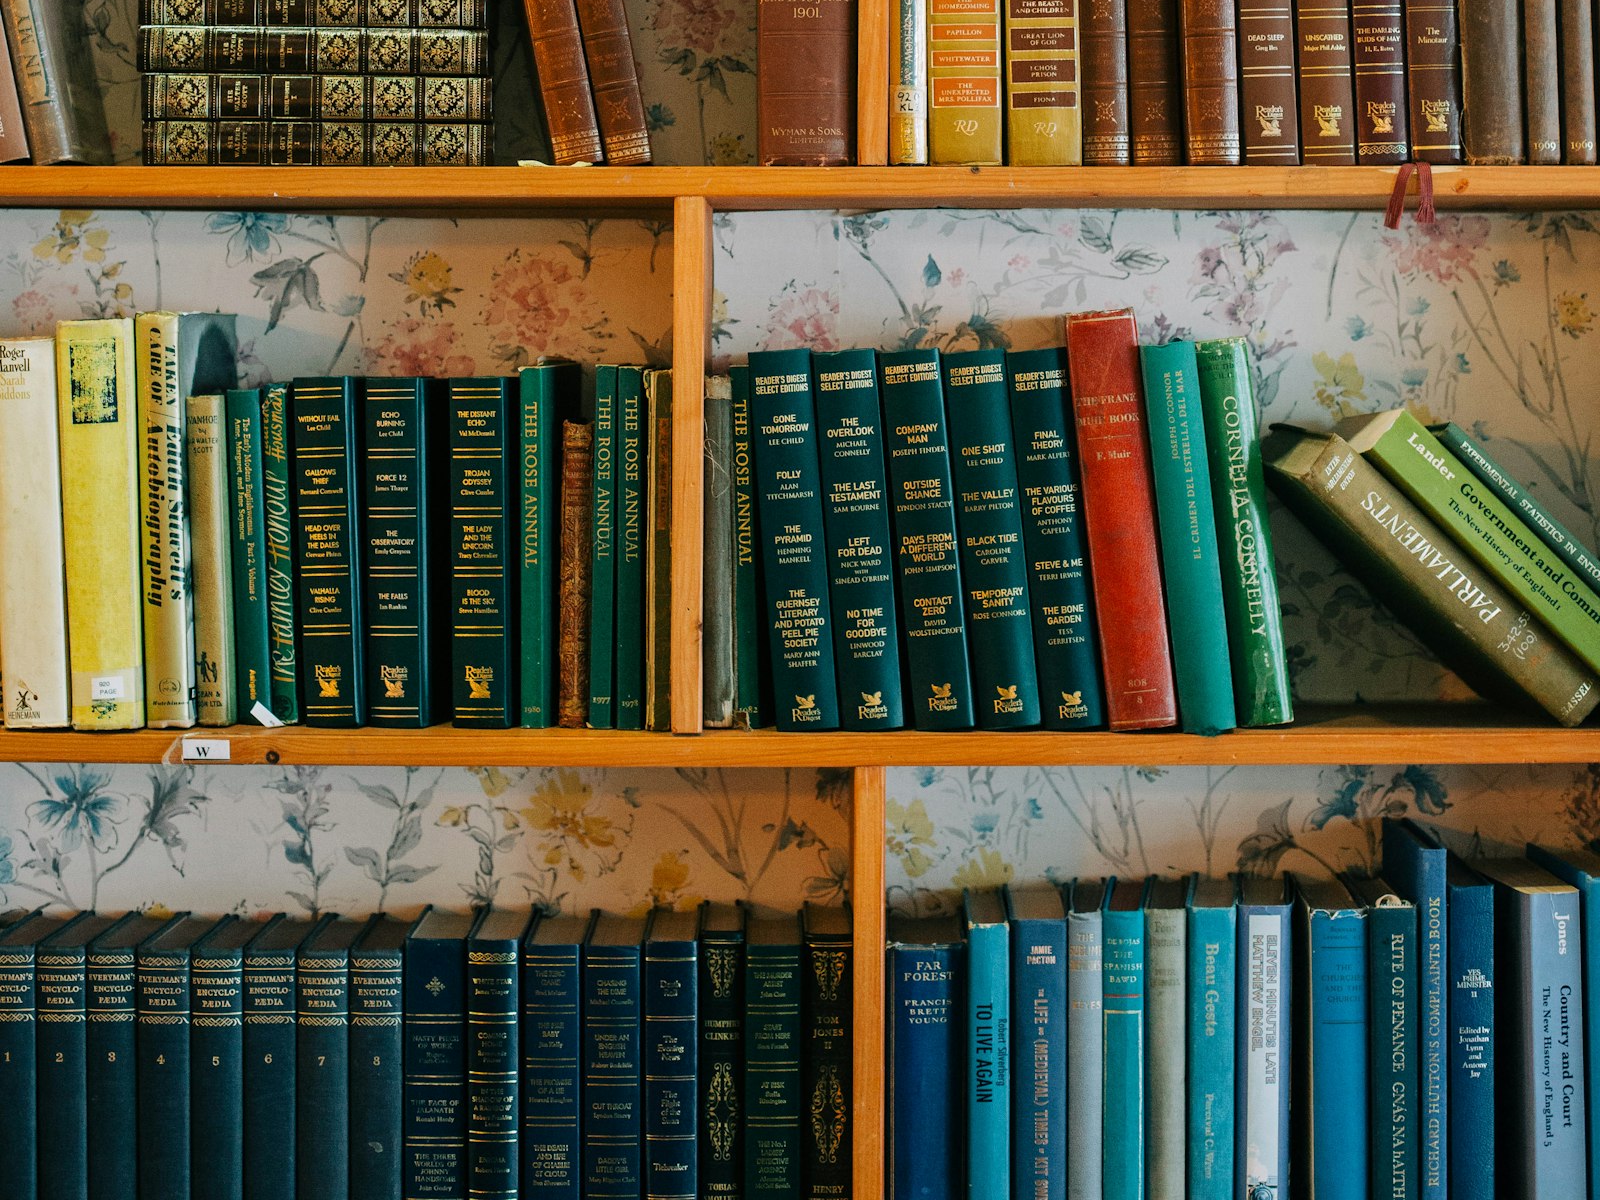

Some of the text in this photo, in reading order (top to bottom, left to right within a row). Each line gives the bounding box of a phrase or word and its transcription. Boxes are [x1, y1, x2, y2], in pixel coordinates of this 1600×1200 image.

[1534, 142, 1556, 151] 1969
[150, 327, 162, 407] CARE OF
[165, 343, 177, 407] TAKEN
[773, 415, 796, 424] GONE
[1164, 372, 1180, 459] JOSEPH O'CONNOR
[761, 423, 808, 434] TOMORROW
[896, 424, 938, 435] COMPANY
[908, 435, 928, 444] MAN
[962, 445, 1005, 455] ONE SHOT
[1407, 432, 1455, 481] Lander
[525, 402, 538, 568] THE ROSE ANNUAL
[146, 417, 165, 607] Autobiography
[1224, 396, 1267, 637] CORNELIA CONNELLY
[1460, 483, 1563, 585] Government and
[1360, 490, 1501, 624] PARLIAMENTS
[1035, 559, 1083, 570] STEVE & ME
[1128, 679, 1147, 687] 808
[100, 687, 117, 695] PAGE
[8, 711, 40, 720] HEINEMANN
[196, 745, 210, 757] W
[1555, 912, 1569, 955] Jones
[917, 961, 942, 970] FAR
[139, 976, 186, 984] EVERYMAN'S
[904, 971, 952, 981] FOREST
[1252, 935, 1264, 1051] MATTHEW ENGEL
[1392, 934, 1404, 1072] RITE OF PENANCE
[1266, 935, 1277, 1084] ELEVEN MINUTES LATE
[909, 1016, 947, 1024] YOUNG
[1543, 1010, 1551, 1034] New
[976, 1004, 992, 1103] TO LIVE AGAIN
[1466, 1044, 1483, 1053] Lynn
[56, 1052, 63, 1062] 2
[212, 1056, 220, 1066] 5
[1543, 1037, 1551, 1076] History
[1558, 985, 1574, 1127] Country and Court
[1544, 1079, 1552, 1091] of
[1544, 1092, 1552, 1136] England
